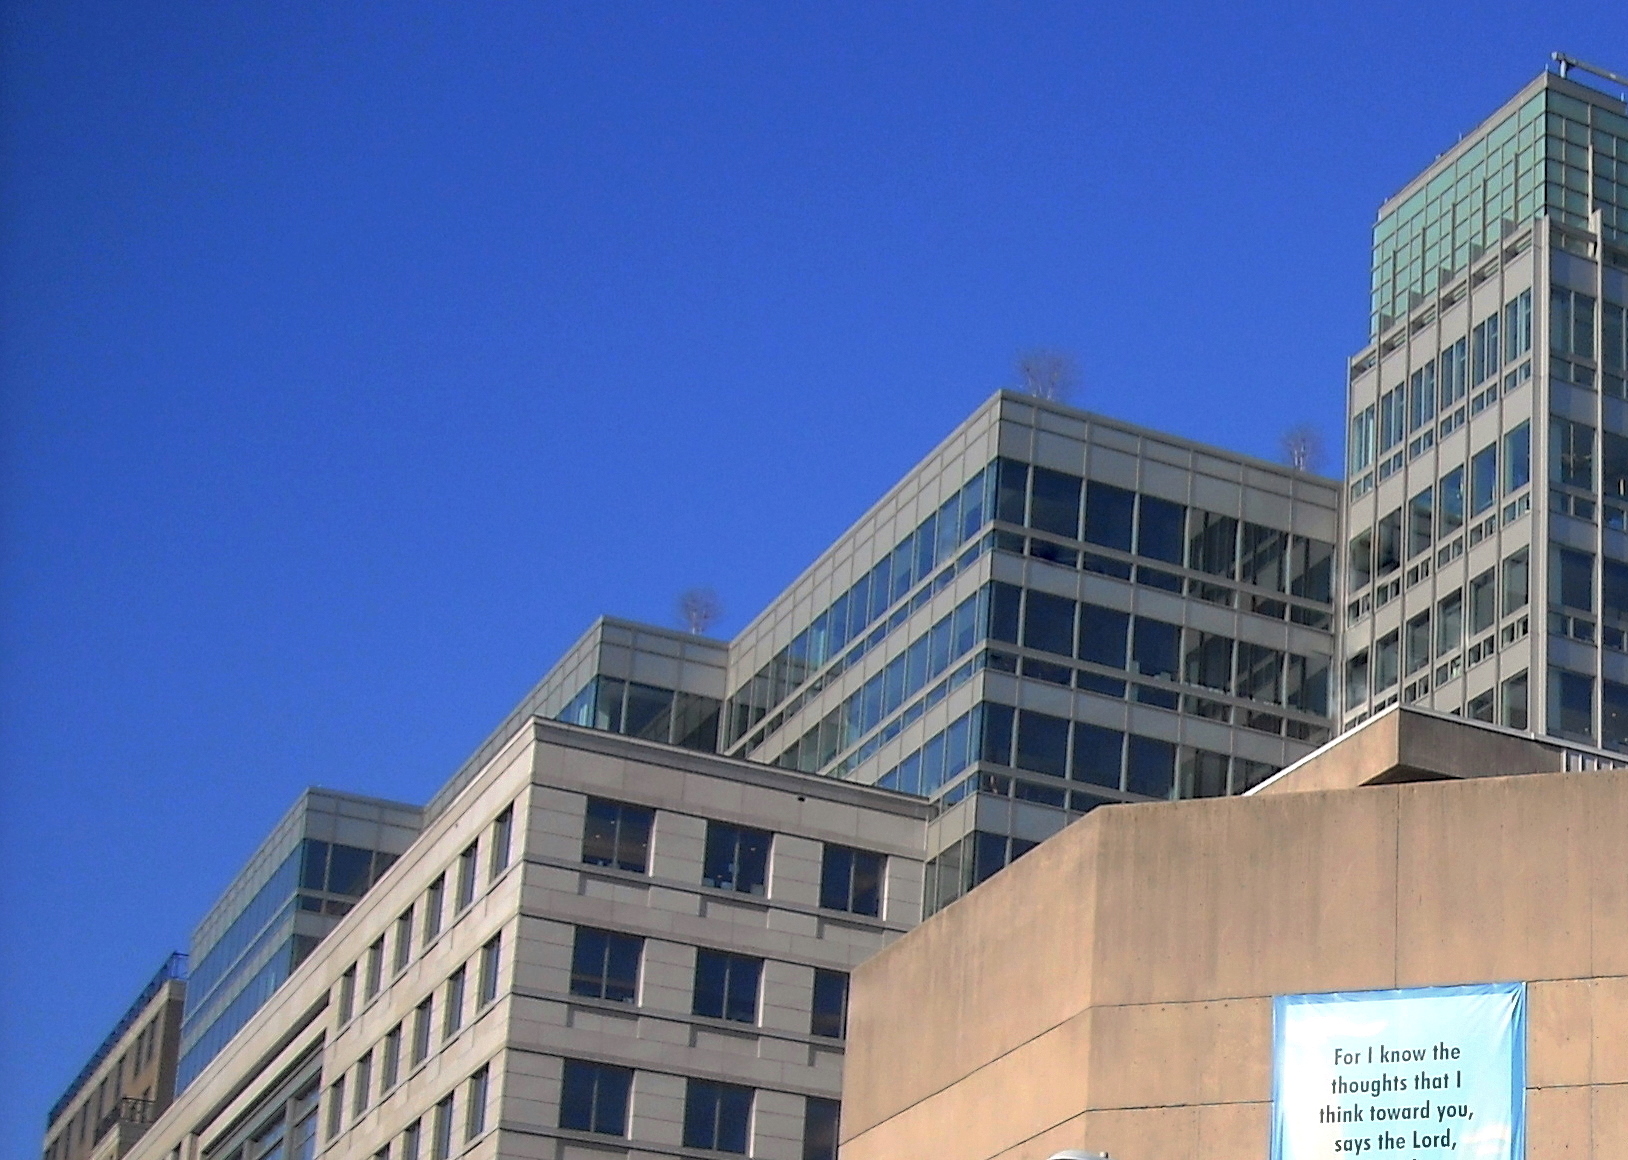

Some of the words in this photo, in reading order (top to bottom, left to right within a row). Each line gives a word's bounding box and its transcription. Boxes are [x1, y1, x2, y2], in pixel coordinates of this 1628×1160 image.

[1334, 1048, 1361, 1065] For
[1368, 1046, 1372, 1063] I
[1380, 1044, 1426, 1063] know
[1433, 1041, 1461, 1060] the
[1331, 1073, 1407, 1097] thoughts
[1414, 1070, 1449, 1090] that
[1456, 1070, 1461, 1088] I
[1319, 1103, 1363, 1123] think
[1369, 1100, 1430, 1121] toward
[1437, 1104, 1473, 1122] you,
[1335, 1138, 1371, 1156] says
[1378, 1130, 1406, 1150] the
[1413, 1128, 1457, 1150] Lord,
